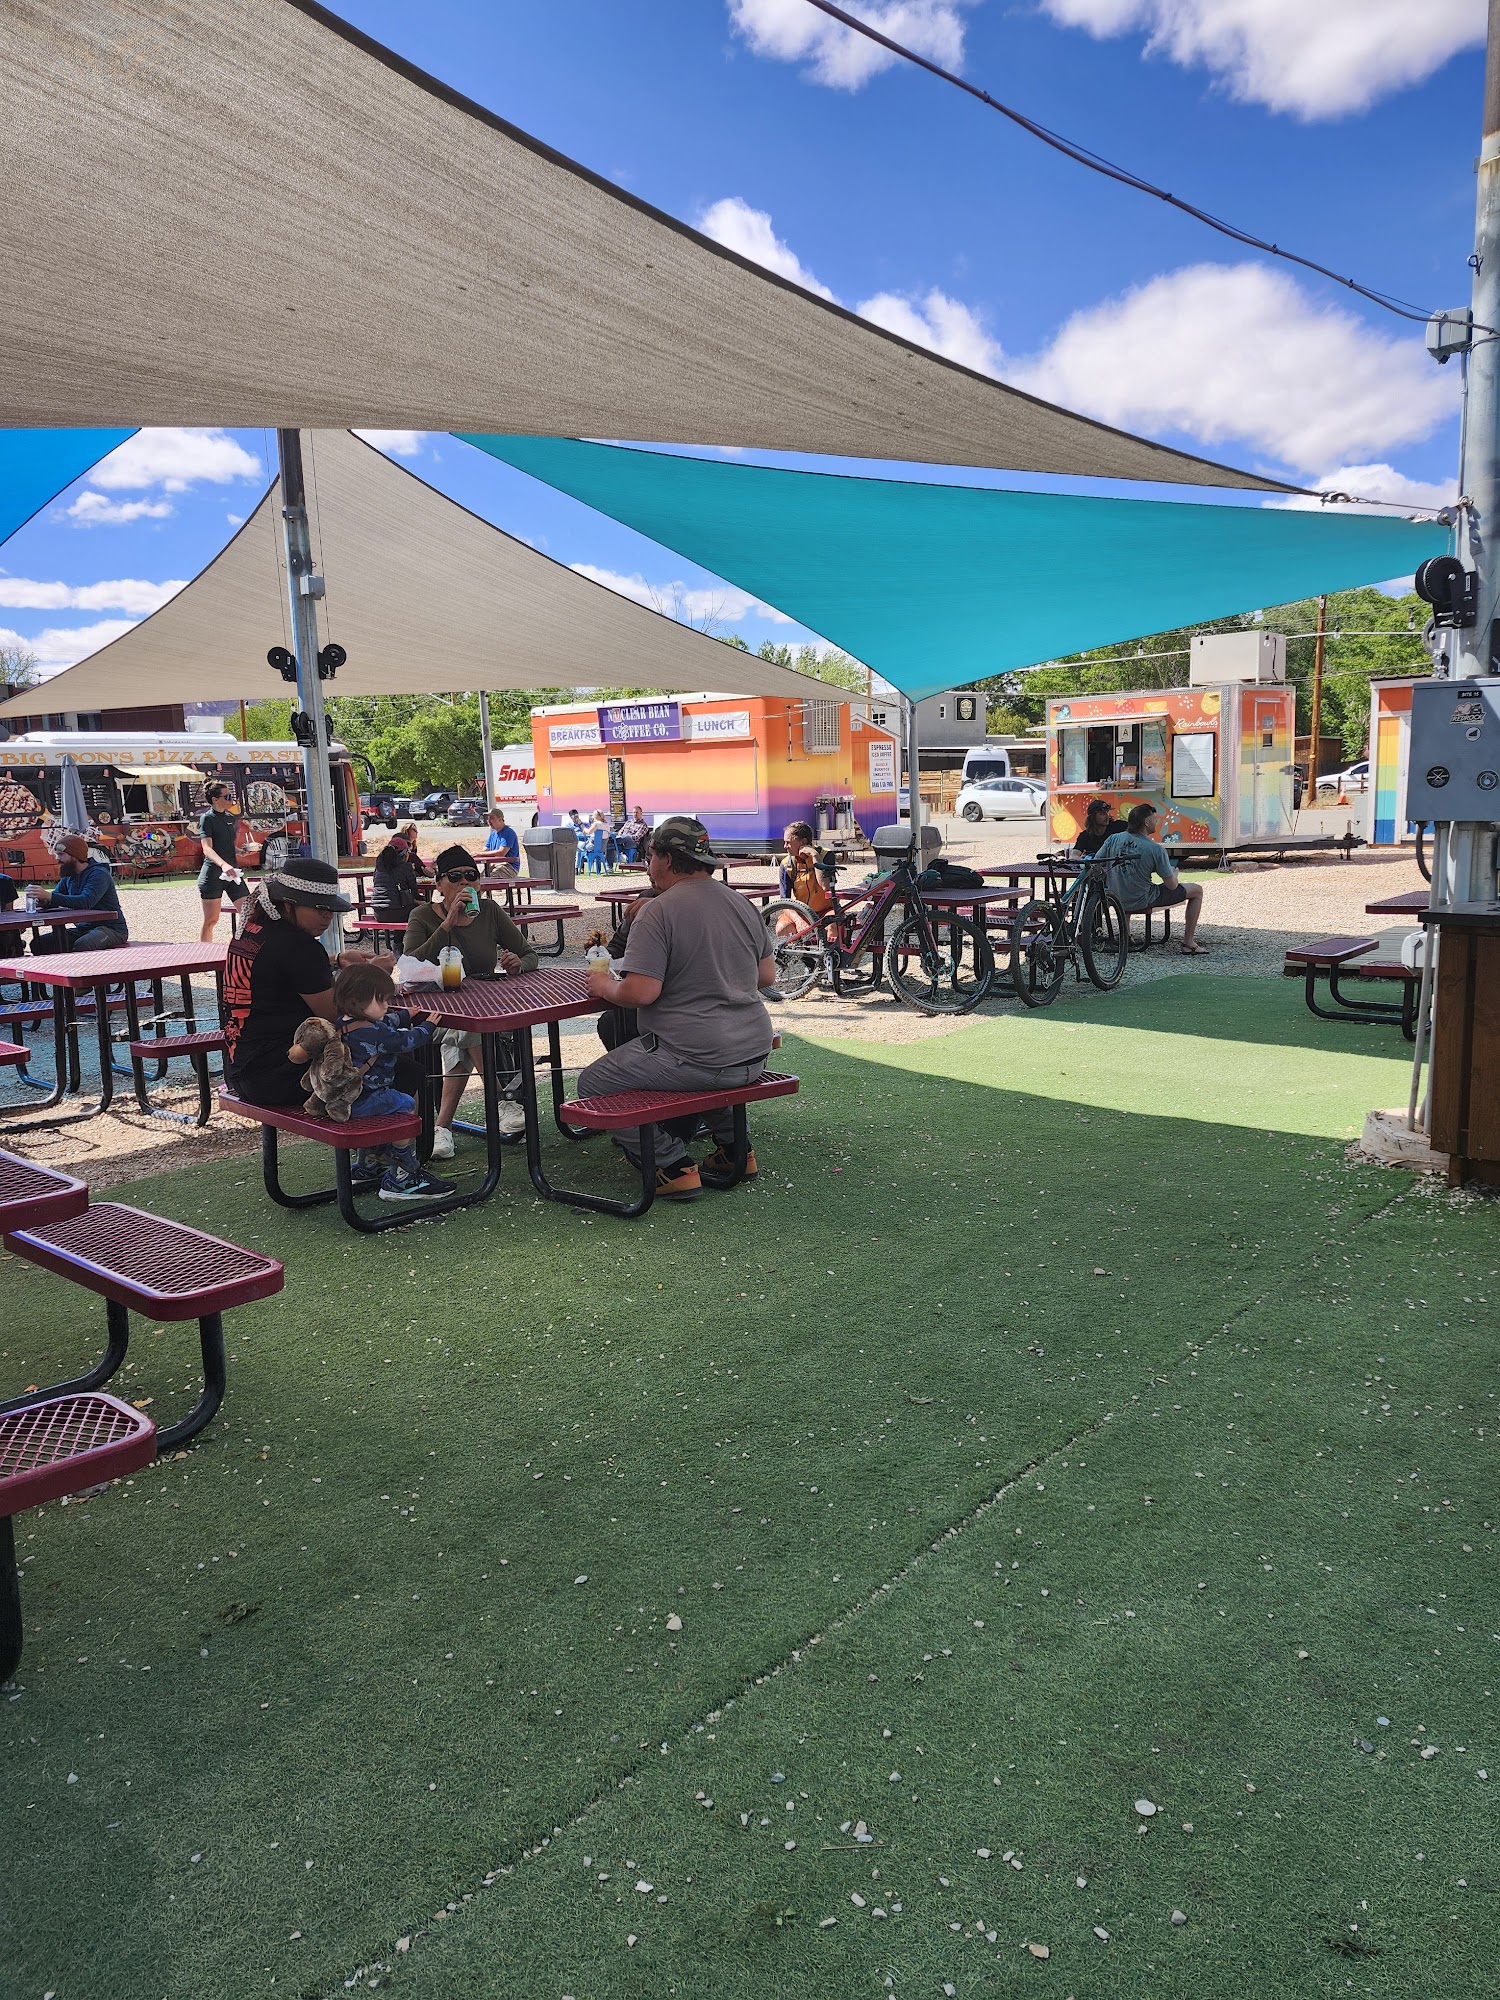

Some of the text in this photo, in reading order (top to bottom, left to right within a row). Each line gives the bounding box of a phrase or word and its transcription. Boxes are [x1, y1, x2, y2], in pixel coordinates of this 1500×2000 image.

[607, 704, 670, 722] NUCLEAR BEAN
[697, 720, 735, 731] LUNCH
[1173, 716, 1218, 729] Rainbowls
[612, 723, 669, 741] COFFEE CO.
[1123, 729, 1129, 737] A
[0, 752, 47, 765] BIG
[143, 749, 218, 763] PIZZA
[226, 752, 241, 762] &
[498, 764, 536, 784] Snap
[141, 831, 161, 841] open
